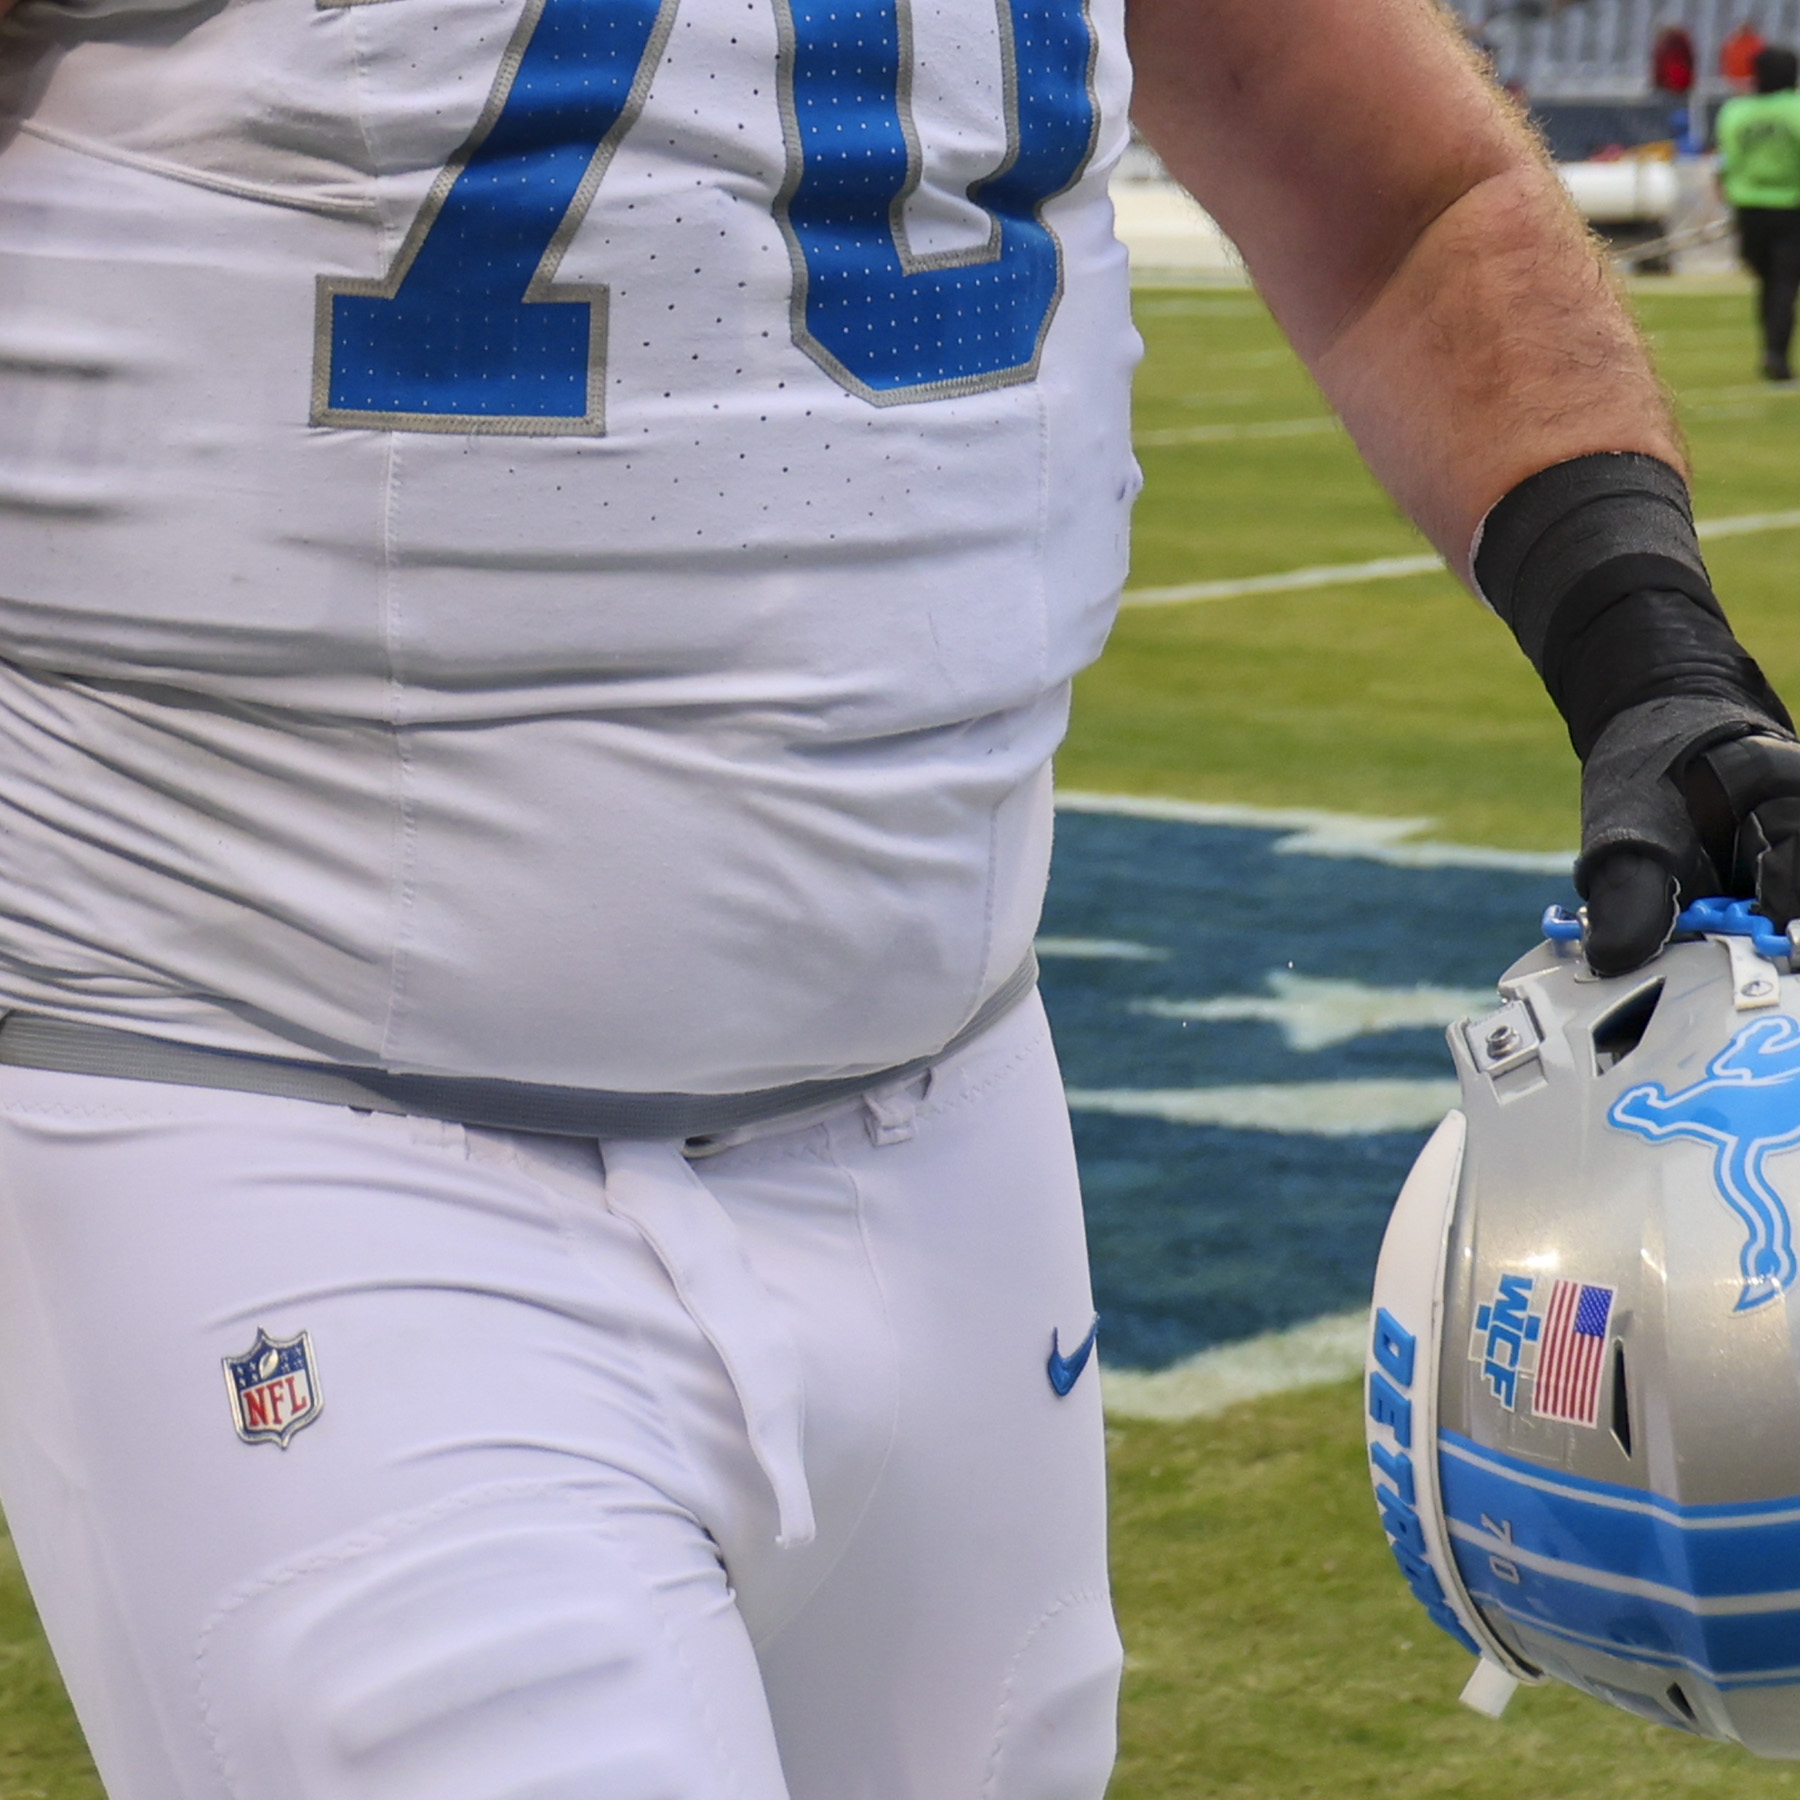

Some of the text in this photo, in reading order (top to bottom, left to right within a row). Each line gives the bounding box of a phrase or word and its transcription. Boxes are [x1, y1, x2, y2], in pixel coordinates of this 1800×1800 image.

[1483, 1273, 1534, 1410] WCF
[242, 1376, 308, 1427] NFL
[1481, 1513, 1521, 1585] 70
